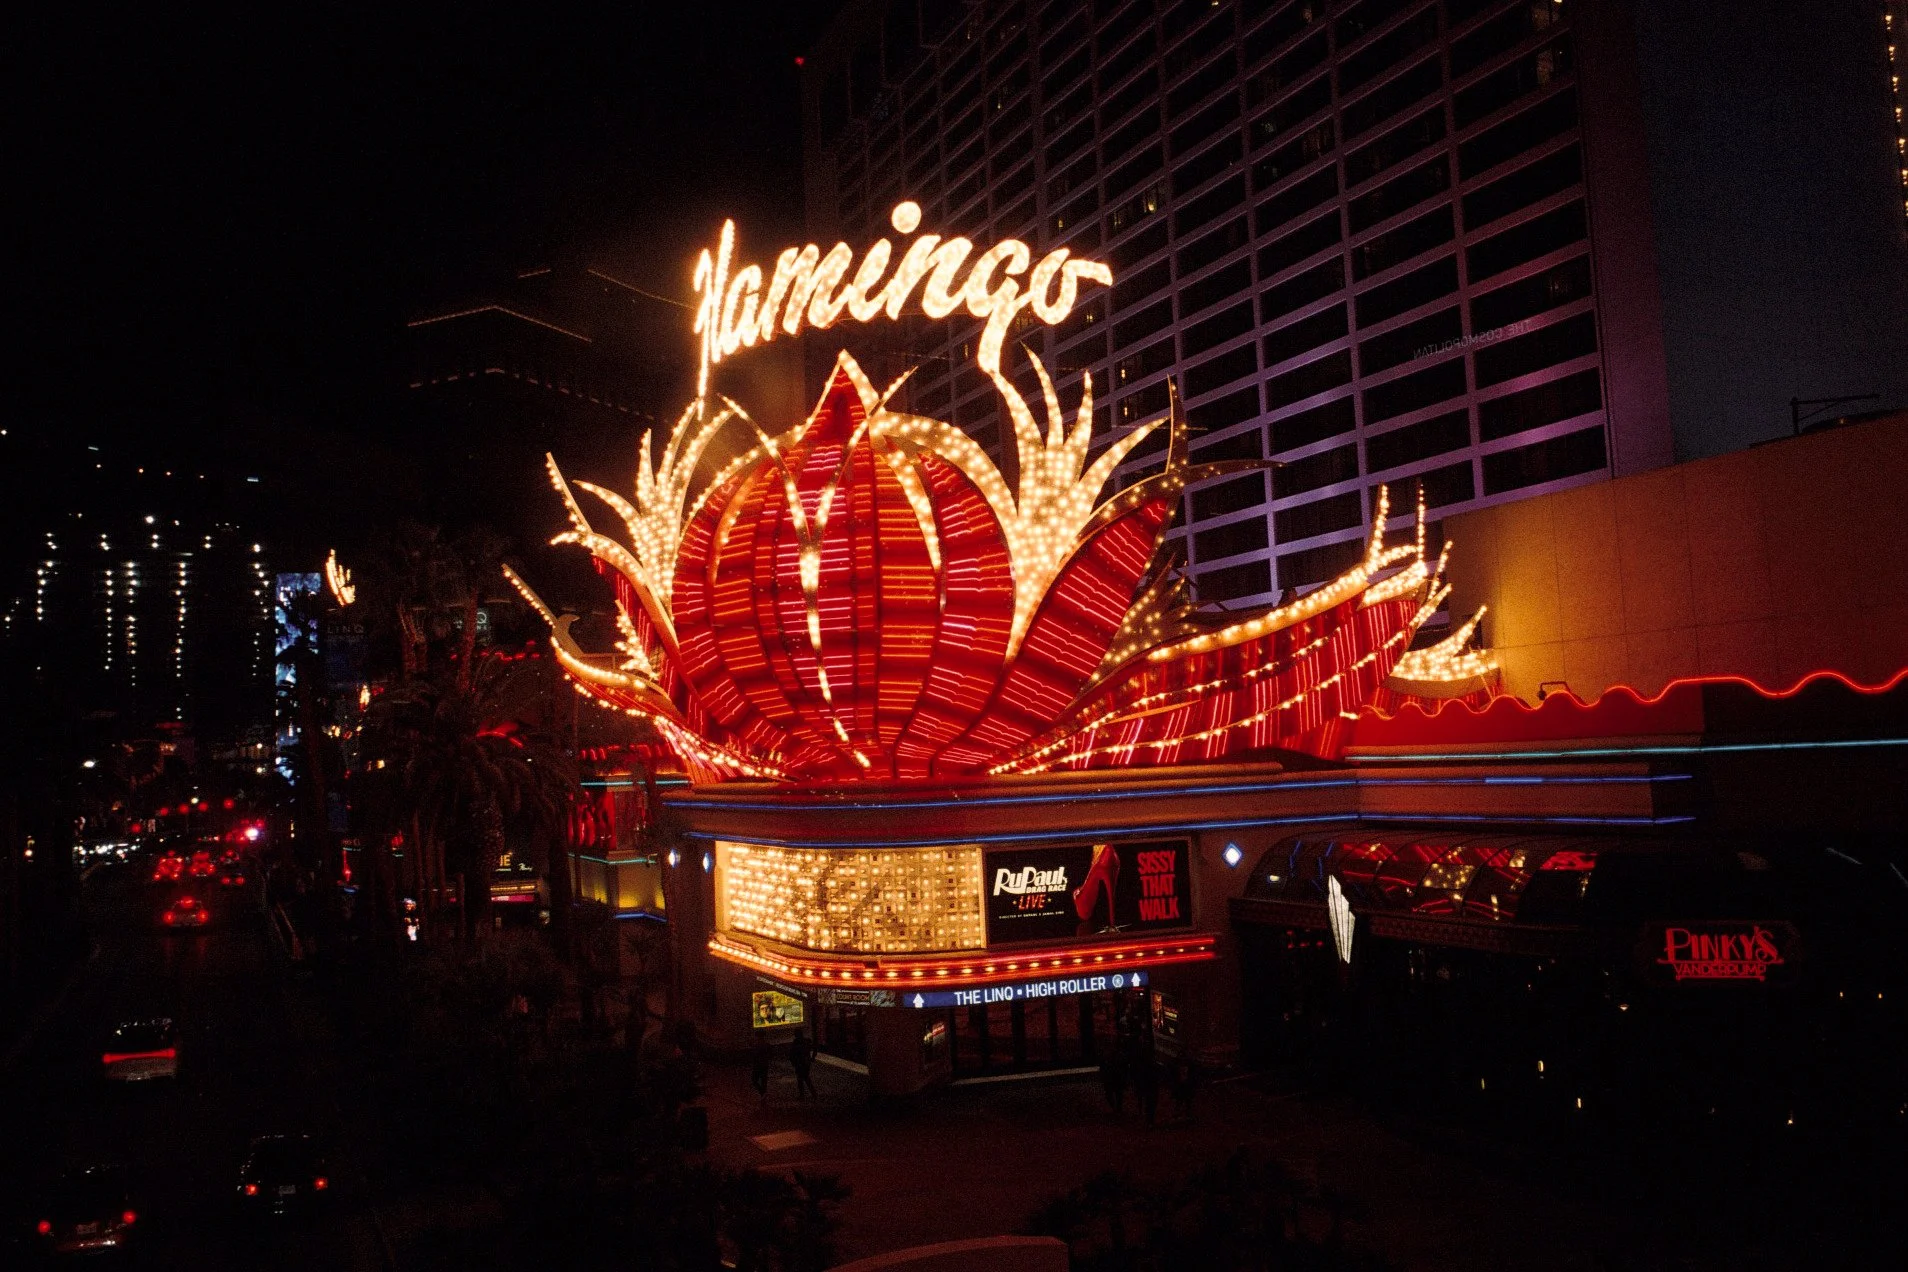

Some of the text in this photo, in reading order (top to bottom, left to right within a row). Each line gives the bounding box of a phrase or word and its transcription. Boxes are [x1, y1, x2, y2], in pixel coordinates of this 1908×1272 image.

[694, 201, 1113, 390] Flamingo
[1137, 851, 1176, 875] SISSY
[1026, 884, 1067, 894] DRAG RACE
[1140, 875, 1175, 897] THAT
[1019, 894, 1046, 910] LIVE
[1139, 896, 1180, 921] WALK
[1664, 926, 1779, 962] PINKY'S
[954, 977, 1106, 1005] THE LINQ HIGH ROLLER
